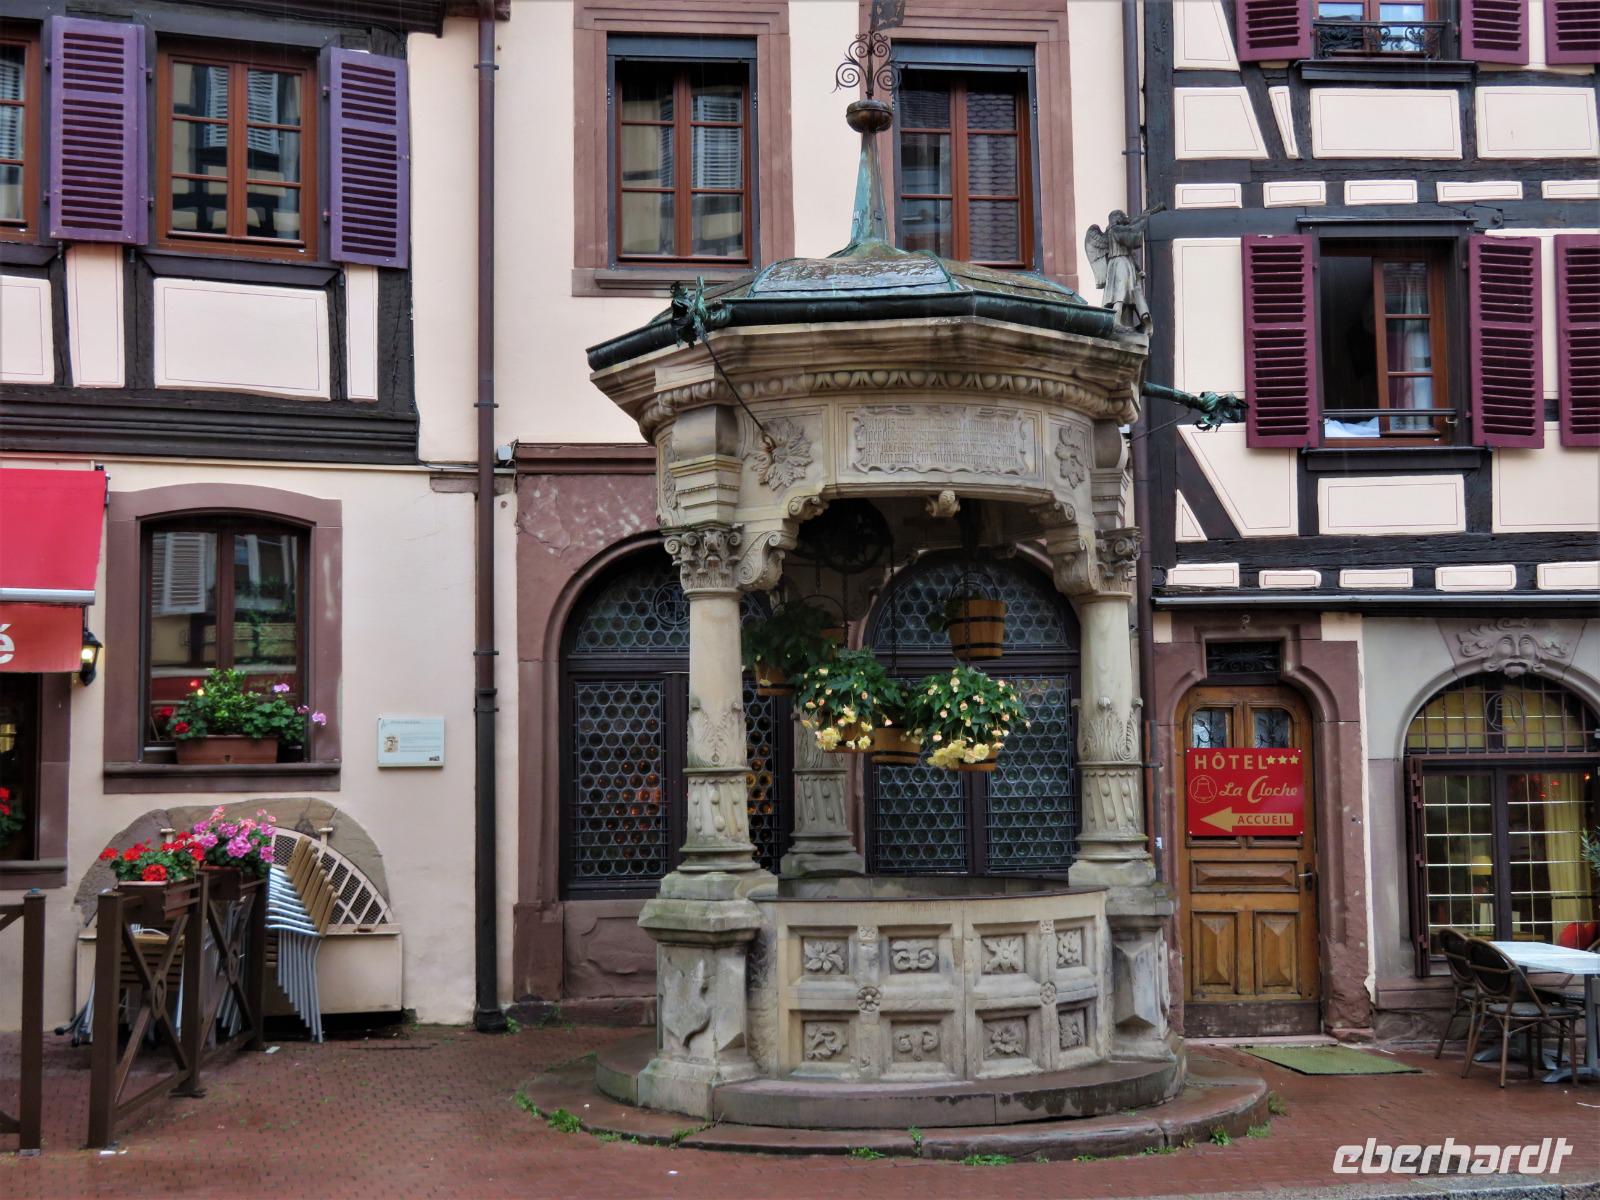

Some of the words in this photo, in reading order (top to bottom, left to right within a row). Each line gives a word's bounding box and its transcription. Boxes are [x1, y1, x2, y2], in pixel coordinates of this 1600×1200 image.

[1194, 752, 1268, 770] HÔTEL
[1219, 782, 1243, 796] La
[1247, 775, 1298, 803] Cloche
[1237, 815, 1290, 825] ACCUEIL
